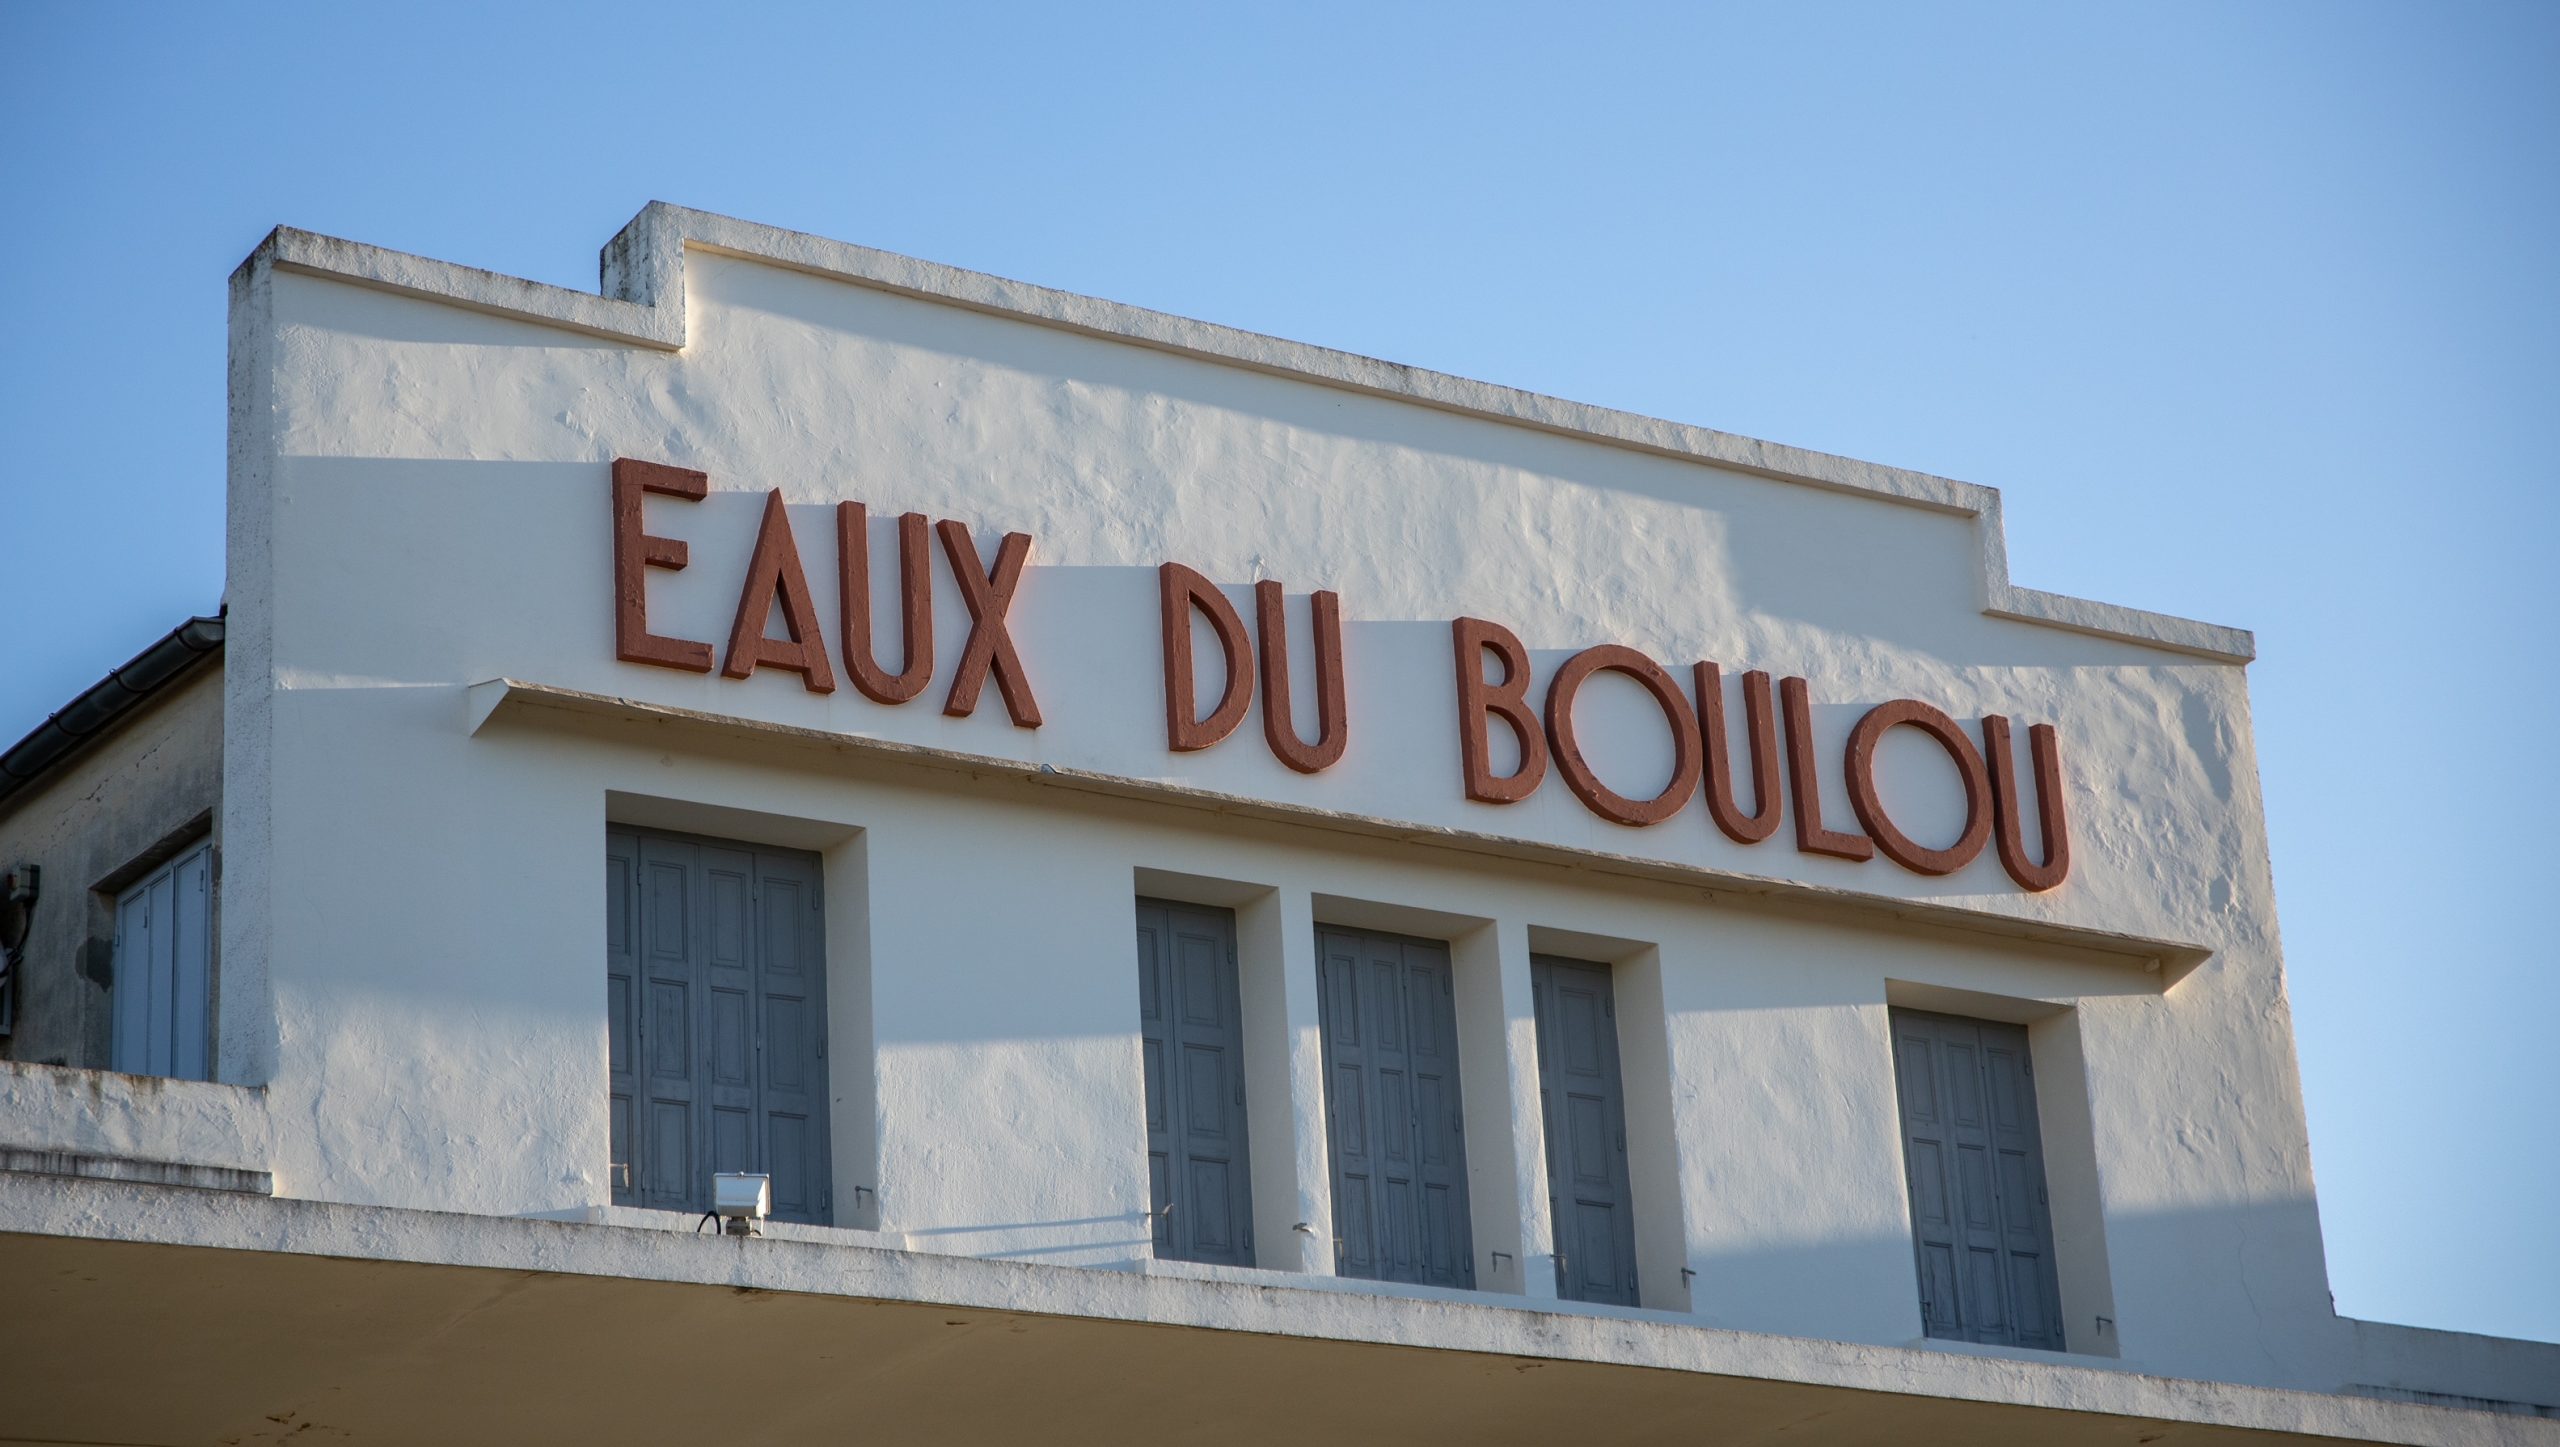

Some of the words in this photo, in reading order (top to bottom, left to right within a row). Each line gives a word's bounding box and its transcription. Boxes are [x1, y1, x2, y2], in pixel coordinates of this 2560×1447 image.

[612, 456, 1043, 729] EAUX
[1160, 561, 1349, 774] DU
[1453, 617, 2072, 895] BOULOU
